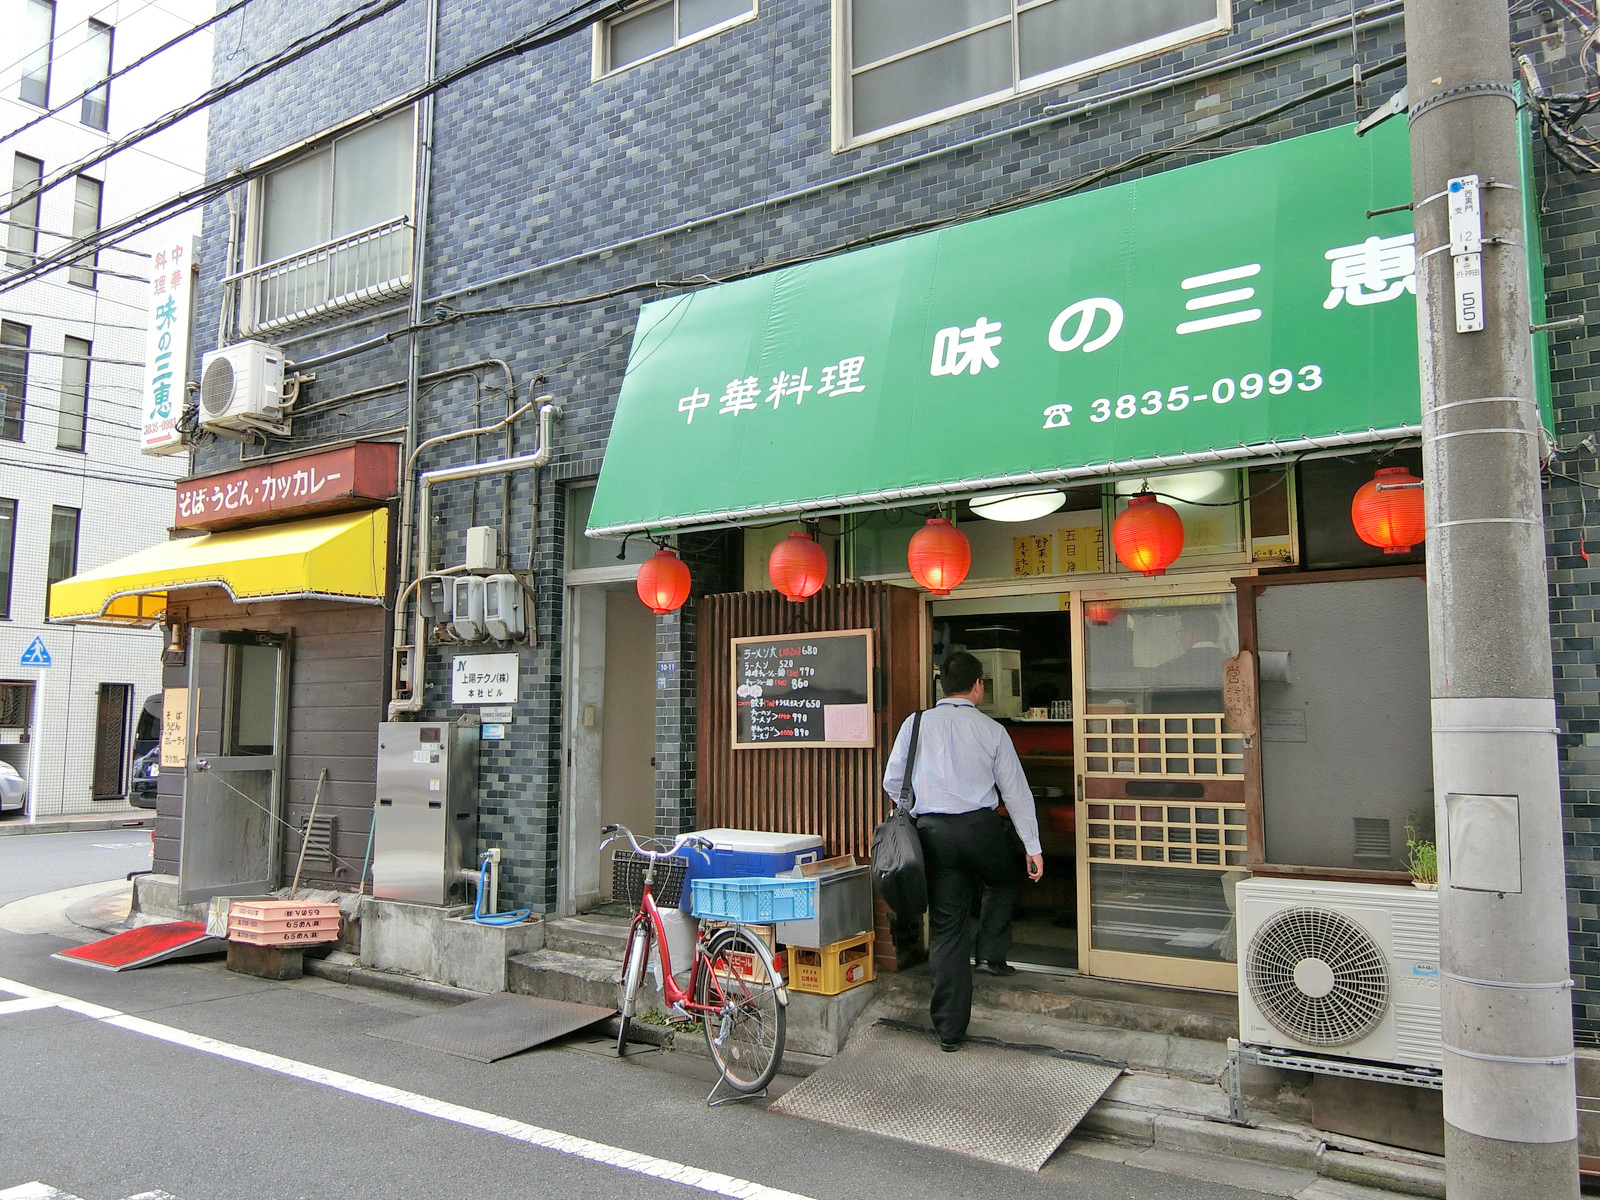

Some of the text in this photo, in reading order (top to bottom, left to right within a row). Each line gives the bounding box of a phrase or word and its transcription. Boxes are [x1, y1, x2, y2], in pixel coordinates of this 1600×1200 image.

[1459, 231, 1473, 242] 12
[930, 233, 1417, 377] 味の三恵
[1462, 292, 1476, 321] 55
[149, 294, 178, 420] 味の三恵
[677, 356, 866, 425] 中華料理
[1089, 364, 1324, 423] 3835-0993
[801, 645, 818, 656] 680
[660, 663, 675, 671] 10-11
[744, 660, 794, 670] ラーメン 520
[799, 667, 815, 677] 790
[461, 672, 509, 684] 上陽テクノ(株)
[791, 678, 809, 690] 860
[468, 688, 503, 698] 本社ビル
[805, 700, 821, 708] 650
[792, 712, 808, 723] 990
[794, 729, 809, 738] 890
